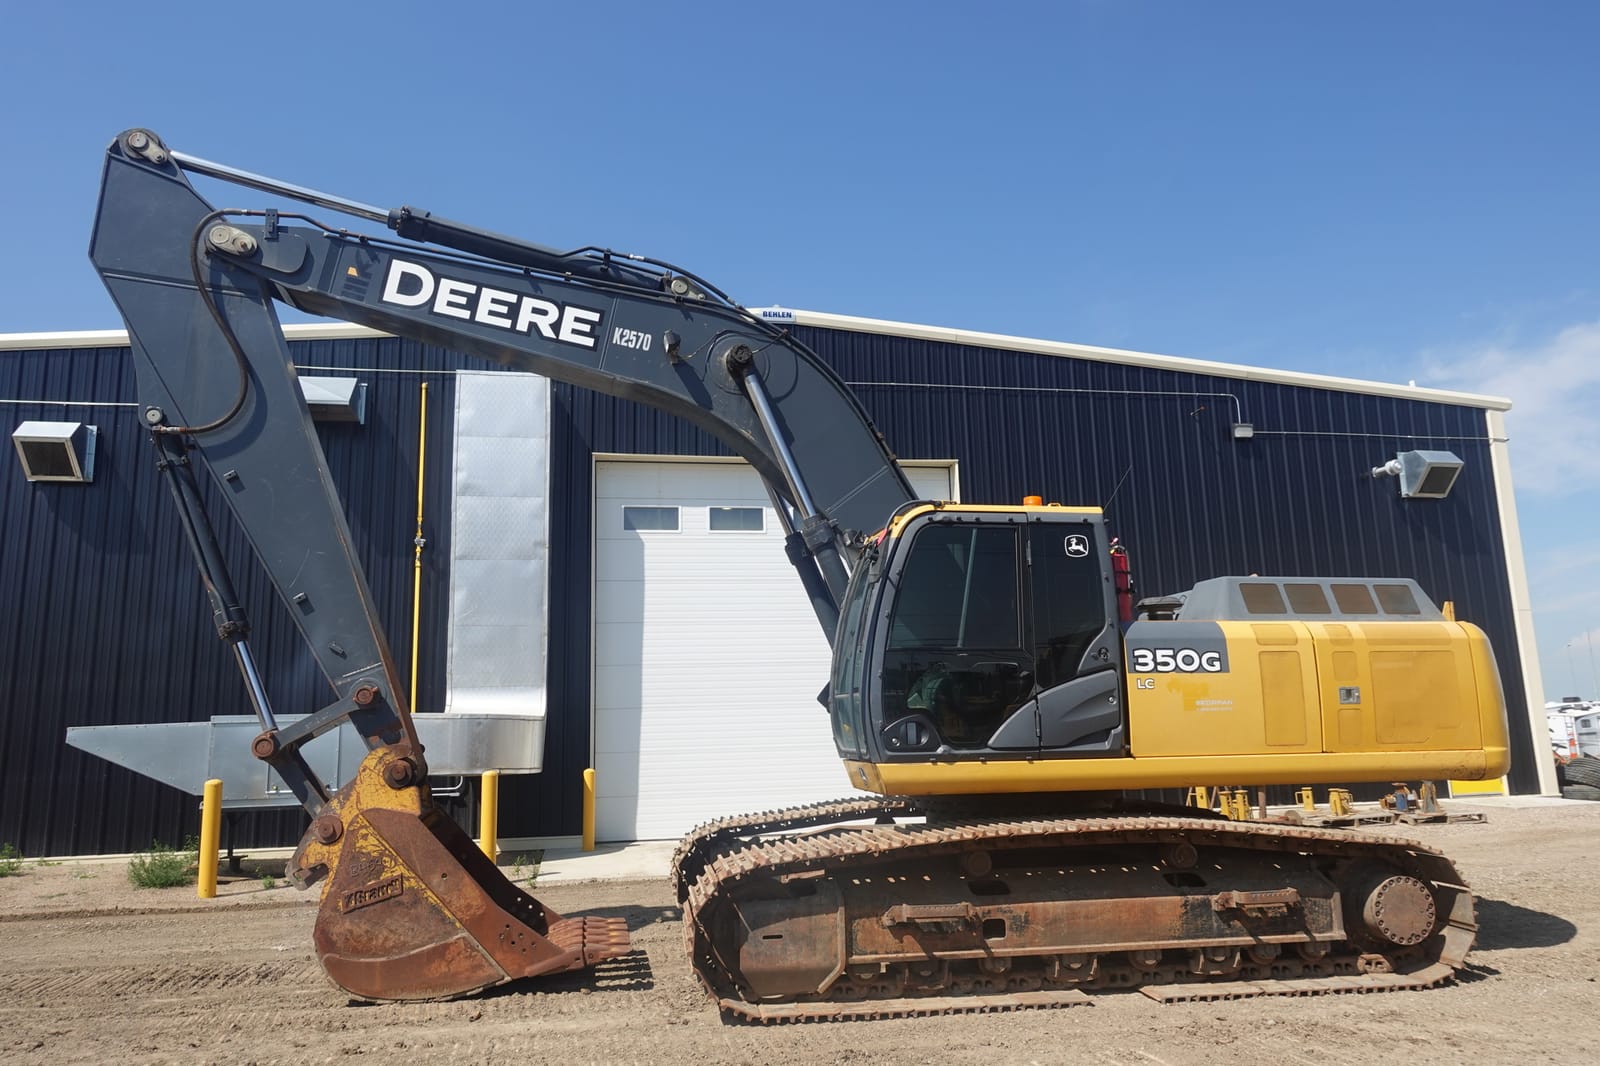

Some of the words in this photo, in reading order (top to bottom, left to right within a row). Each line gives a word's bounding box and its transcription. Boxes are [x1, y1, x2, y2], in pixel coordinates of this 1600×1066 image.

[382, 258, 600, 348] DEERE
[612, 326, 652, 351] K2570
[1133, 648, 1221, 673] 350G
[1137, 679, 1155, 689] LC
